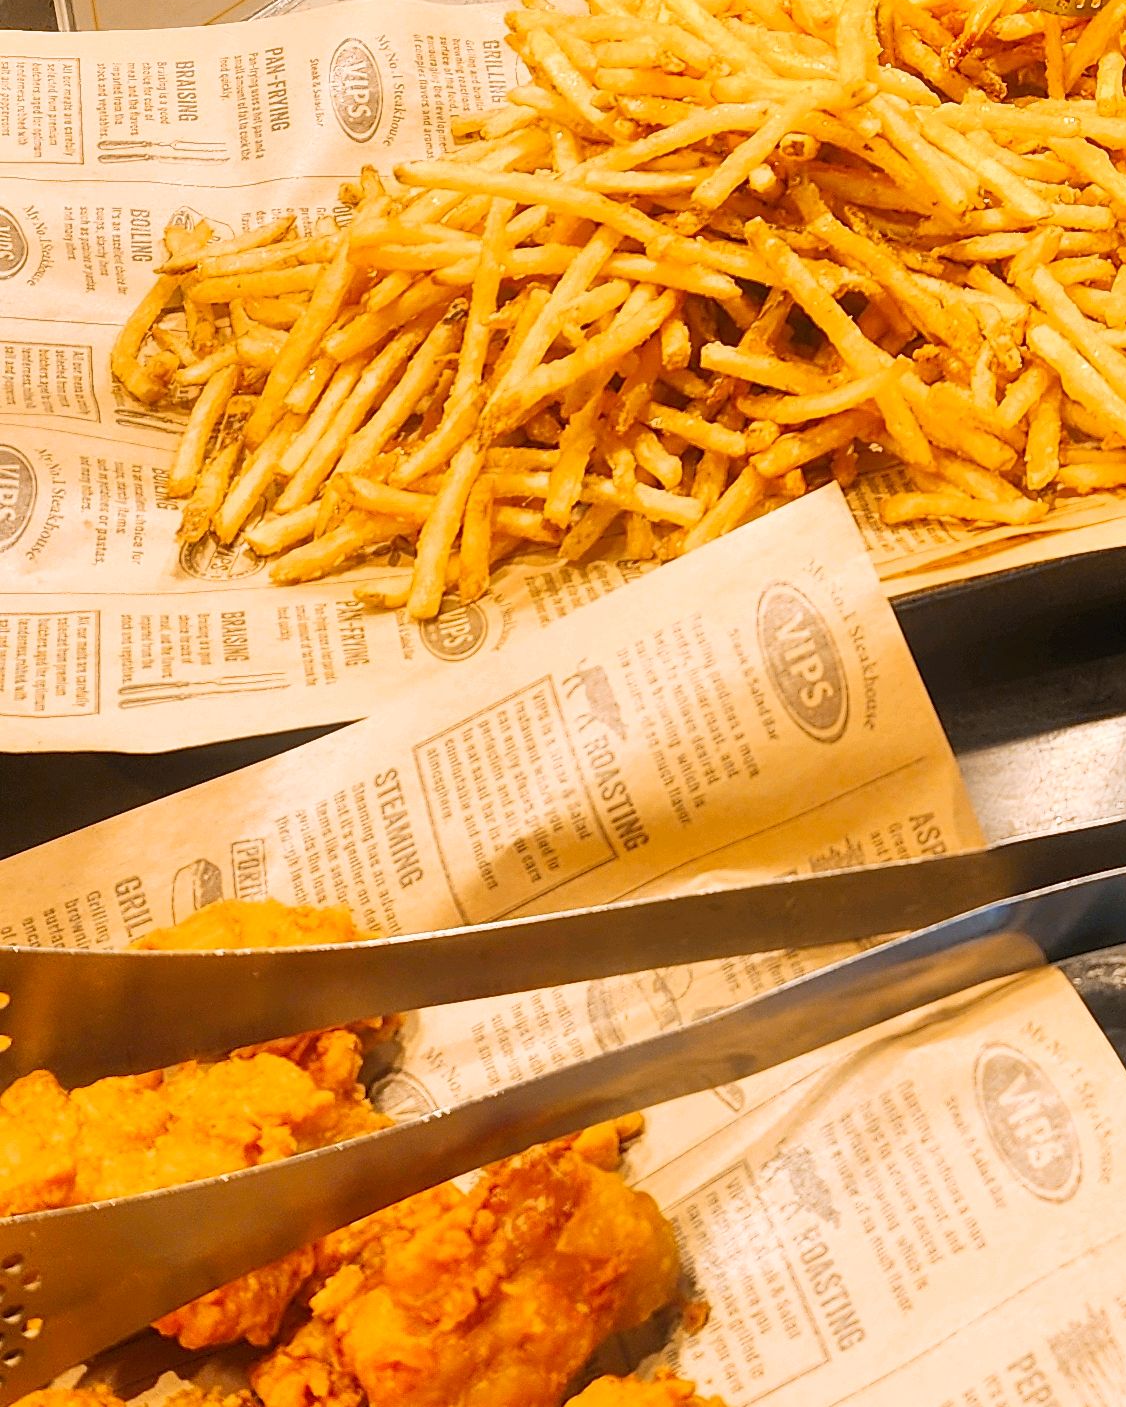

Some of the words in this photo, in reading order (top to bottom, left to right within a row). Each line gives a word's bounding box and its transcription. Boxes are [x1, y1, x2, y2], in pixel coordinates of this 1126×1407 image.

[97, 84, 108, 97] and
[175, 61, 199, 121] BRAISING
[265, 47, 291, 132] PAN-FRYING
[344, 59, 372, 120] VIPS
[375, 34, 388, 50] My
[382, 83, 407, 147] Steakhouse
[419, 80, 430, 107] flavors
[483, 39, 507, 103] GRILLING
[113, 96, 124, 112] from
[422, 110, 432, 126] and
[423, 128, 434, 159] aromas
[130, 208, 153, 262] BOILING
[0, 464, 19, 524] VIPS
[221, 610, 250, 662] BRAISING
[335, 601, 370, 667] PAN-FRYING
[438, 608, 473, 648] VIPS
[774, 610, 835, 709] VIPS
[497, 710, 513, 732] can
[464, 745, 479, 762] eat
[503, 735, 526, 769] enjoy
[514, 700, 542, 764] restaurant
[543, 810, 565, 833] you
[467, 766, 492, 801] salad
[583, 735, 649, 851] ROASTING
[693, 794, 707, 808] is
[352, 781, 377, 844] Steaming
[374, 768, 422, 890] STEAMING
[444, 738, 475, 810] comfortable
[463, 814, 481, 838] and
[473, 840, 499, 891] modern
[482, 802, 500, 823] bar
[500, 783, 516, 807] and
[522, 854, 542, 883] care
[523, 818, 554, 856] grilled
[308, 854, 321, 874] the
[367, 845, 380, 868] has
[373, 871, 386, 886] an
[311, 876, 329, 904] loss
[381, 890, 403, 934] advant
[86, 890, 112, 945] Grilling
[999, 1071, 1066, 1169] VIPS
[792, 1224, 866, 1352] ROASTING
